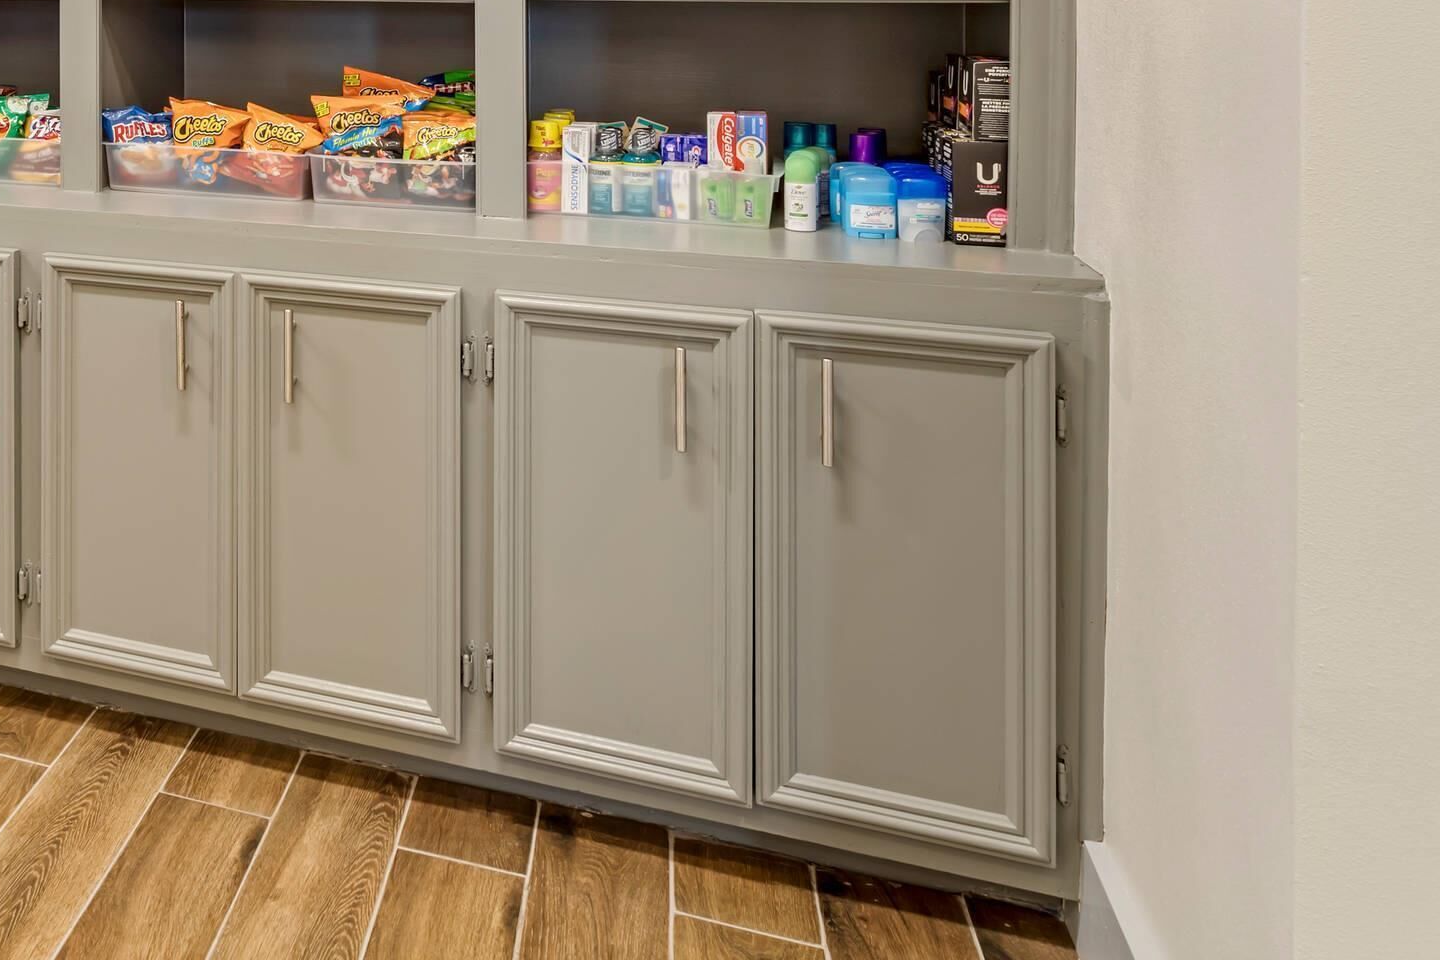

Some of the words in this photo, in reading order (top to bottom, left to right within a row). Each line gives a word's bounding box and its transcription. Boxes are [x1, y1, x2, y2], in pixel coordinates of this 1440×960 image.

[112, 121, 167, 144] RUFFLES
[173, 115, 228, 143] Cheetos
[330, 110, 381, 133] Cheetos
[363, 126, 378, 138] Hot
[254, 122, 305, 146] Cheetos
[417, 125, 458, 144] Cheetos
[721, 117, 735, 167] Colgate
[571, 164, 579, 211] SENSODYNE
[956, 233, 969, 242] 50
